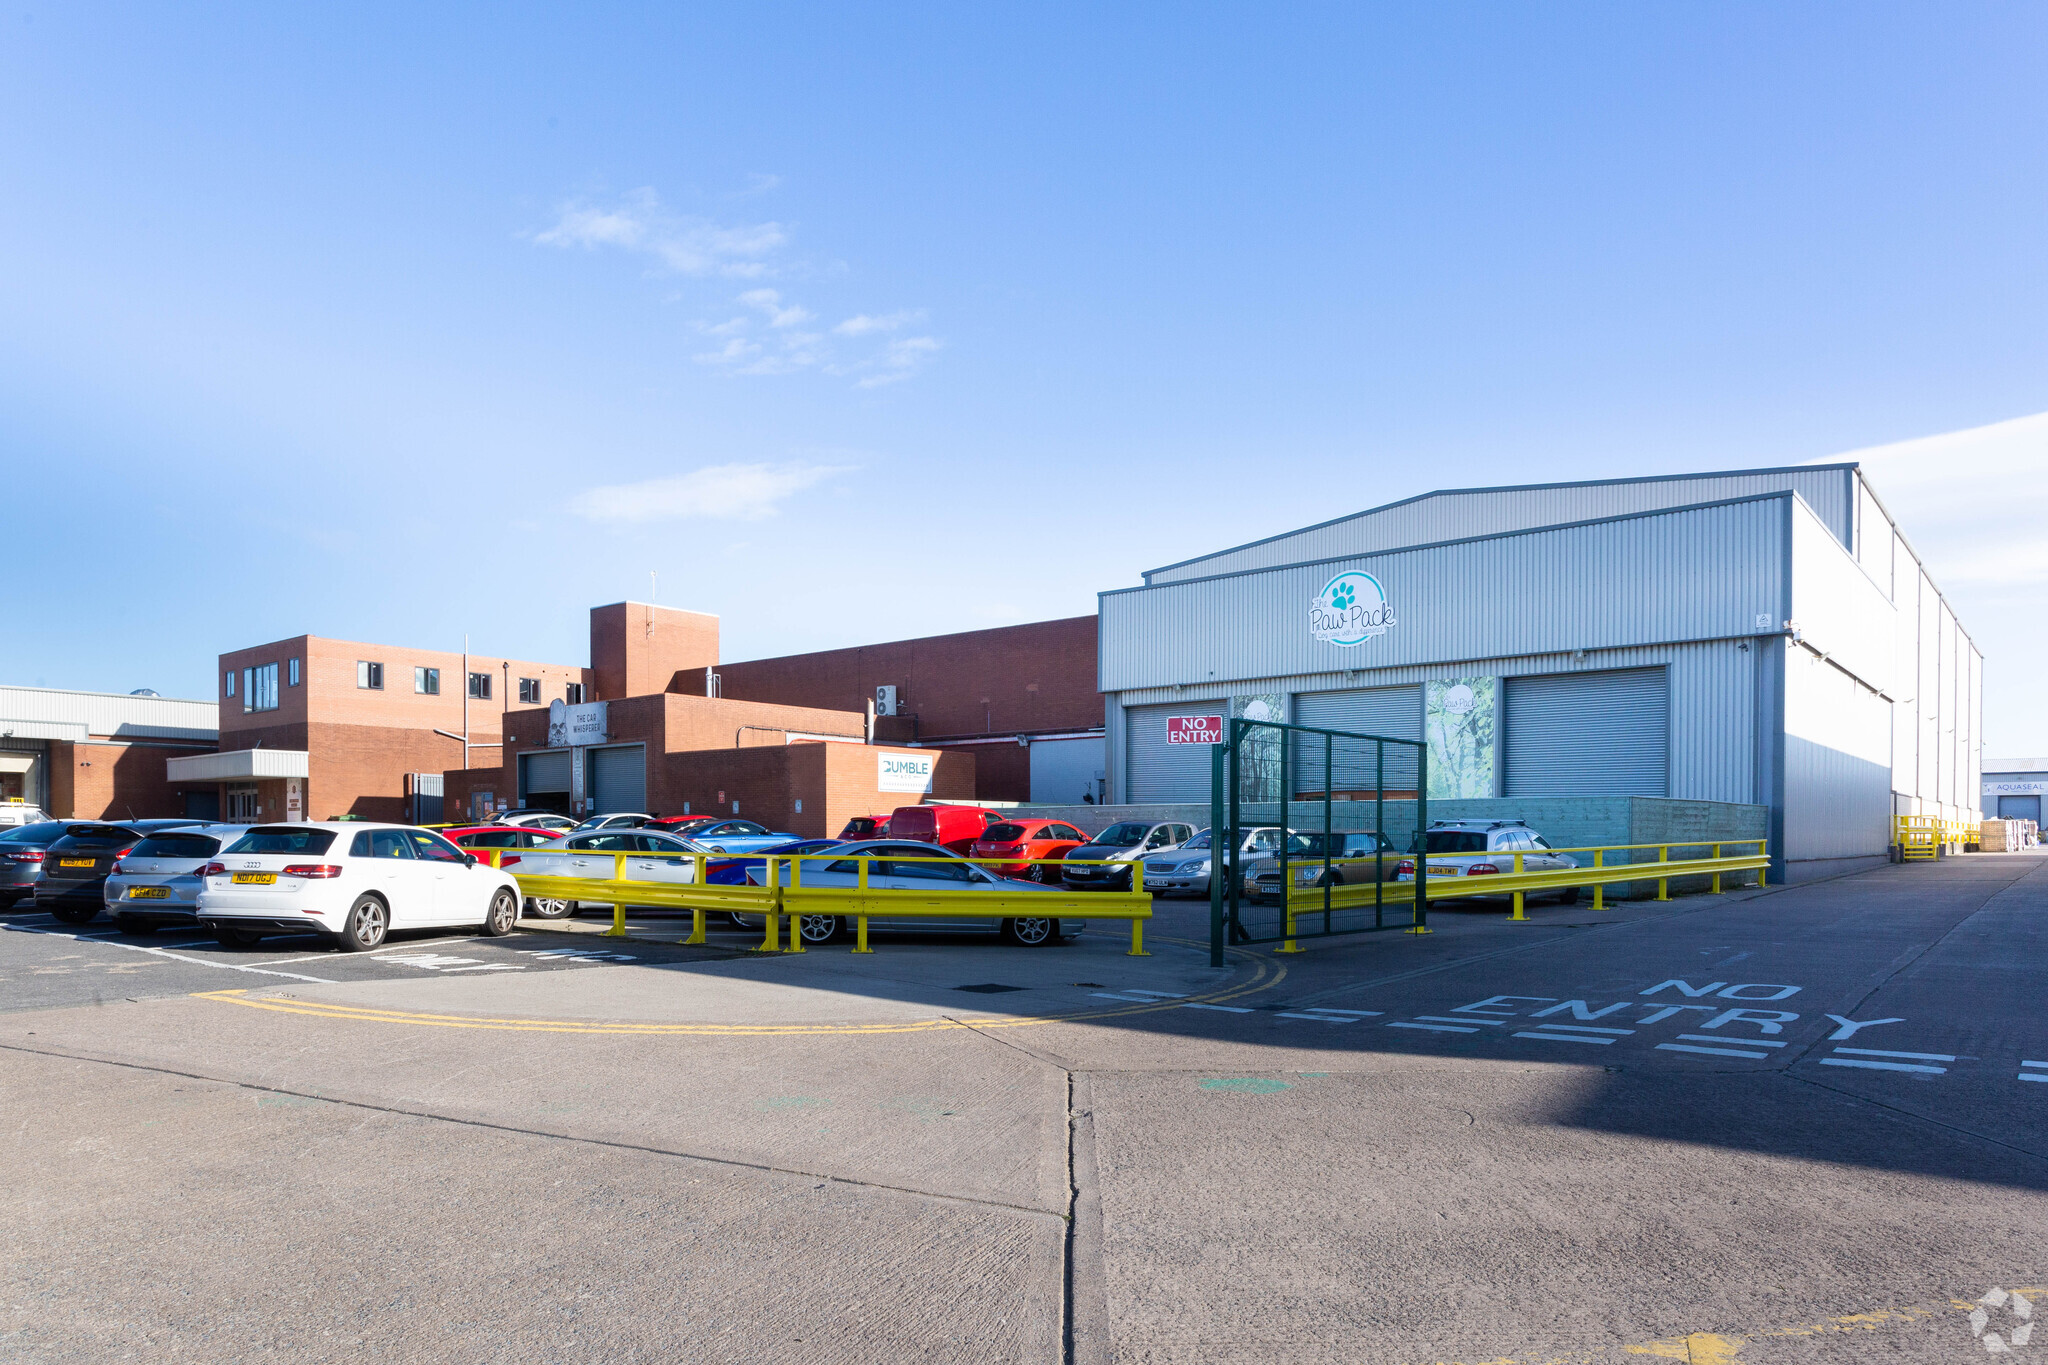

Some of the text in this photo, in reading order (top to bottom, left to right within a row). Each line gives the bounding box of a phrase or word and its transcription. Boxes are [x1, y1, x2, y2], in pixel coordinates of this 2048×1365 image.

[1310, 602, 1395, 632] Paw Pack
[576, 713, 597, 724] THE CAR
[1182, 718, 1208, 730] NO
[573, 723, 601, 733] WHISPERER
[1170, 729, 1220, 743] ENTRY
[1996, 783, 2045, 792] AQUASEAL
[236, 873, 255, 882] ND17
[151, 888, 167, 897] CZD
[1638, 979, 1803, 1001] NO
[1449, 995, 1907, 1041] ENTRY
